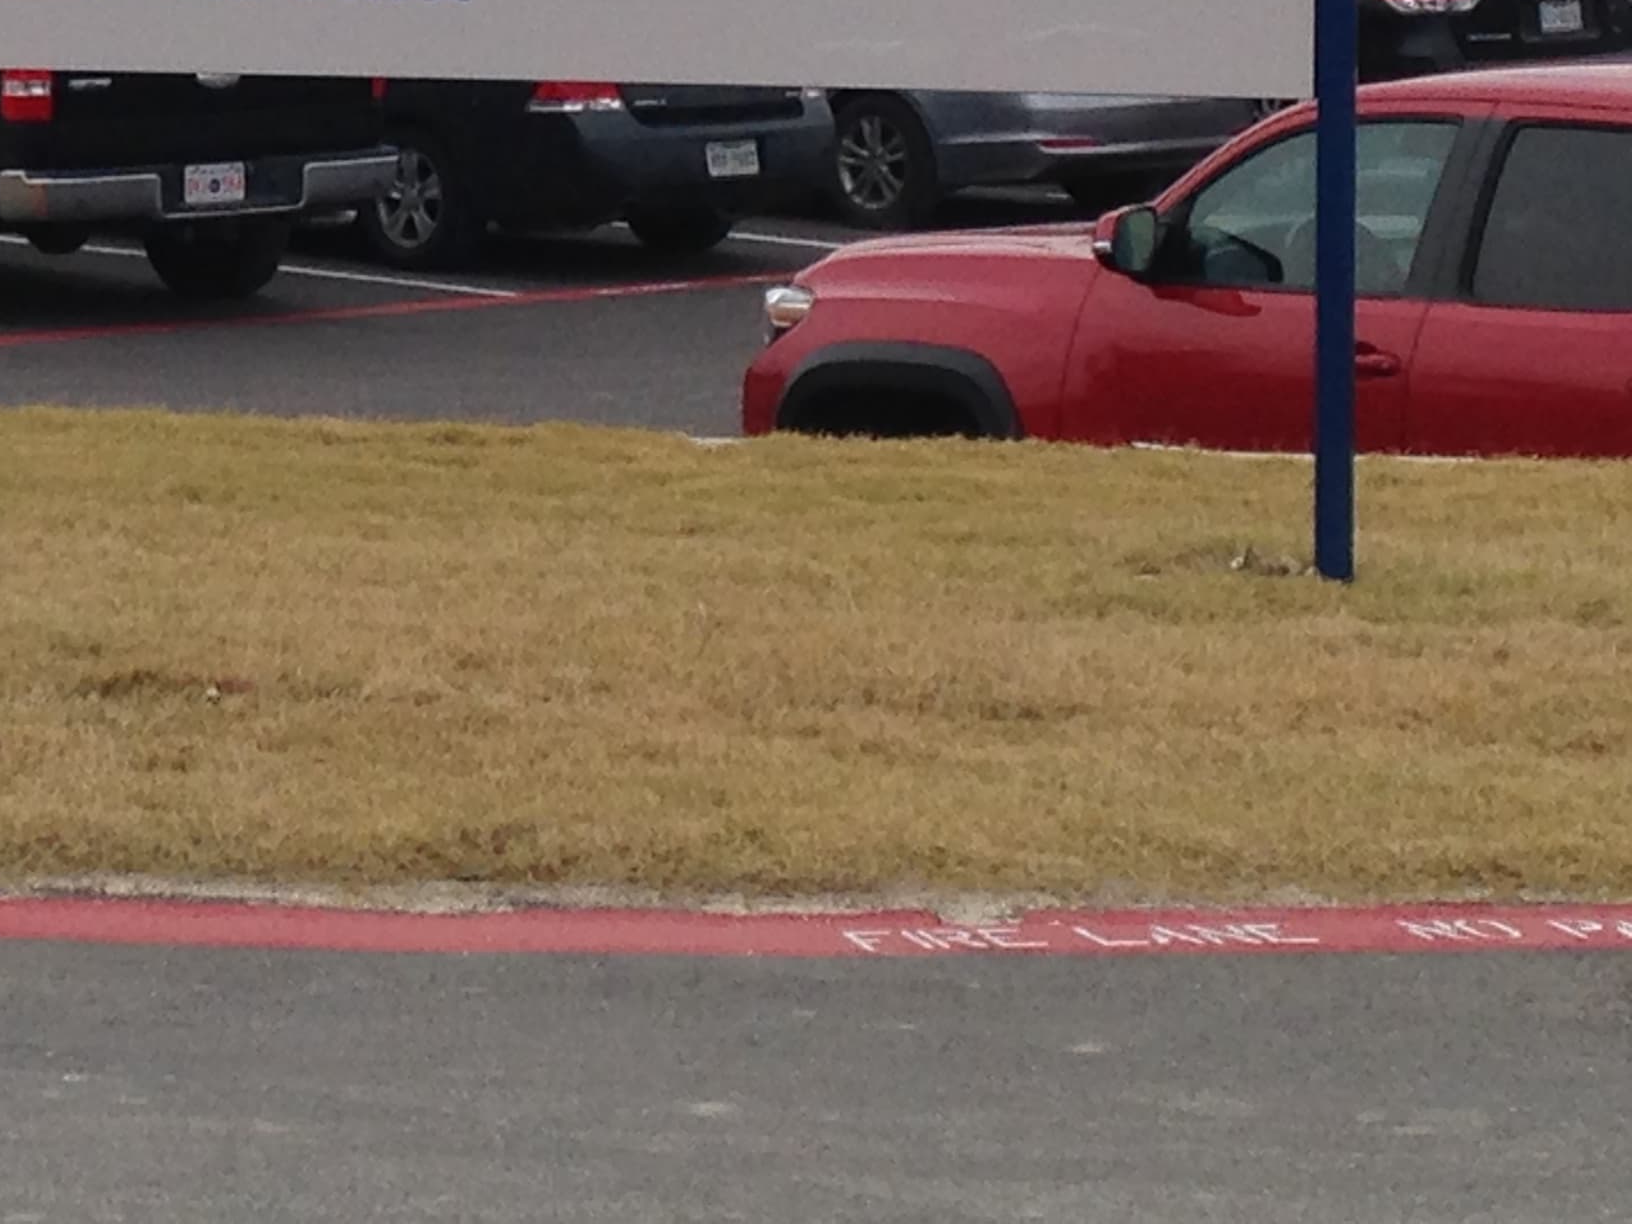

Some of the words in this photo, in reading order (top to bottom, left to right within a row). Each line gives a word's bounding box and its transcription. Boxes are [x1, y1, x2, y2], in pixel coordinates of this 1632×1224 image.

[843, 928, 1049, 952] FIRE
[1073, 923, 1320, 948] LANE
[1394, 919, 1523, 941] NO
[1545, 918, 1632, 941] P
